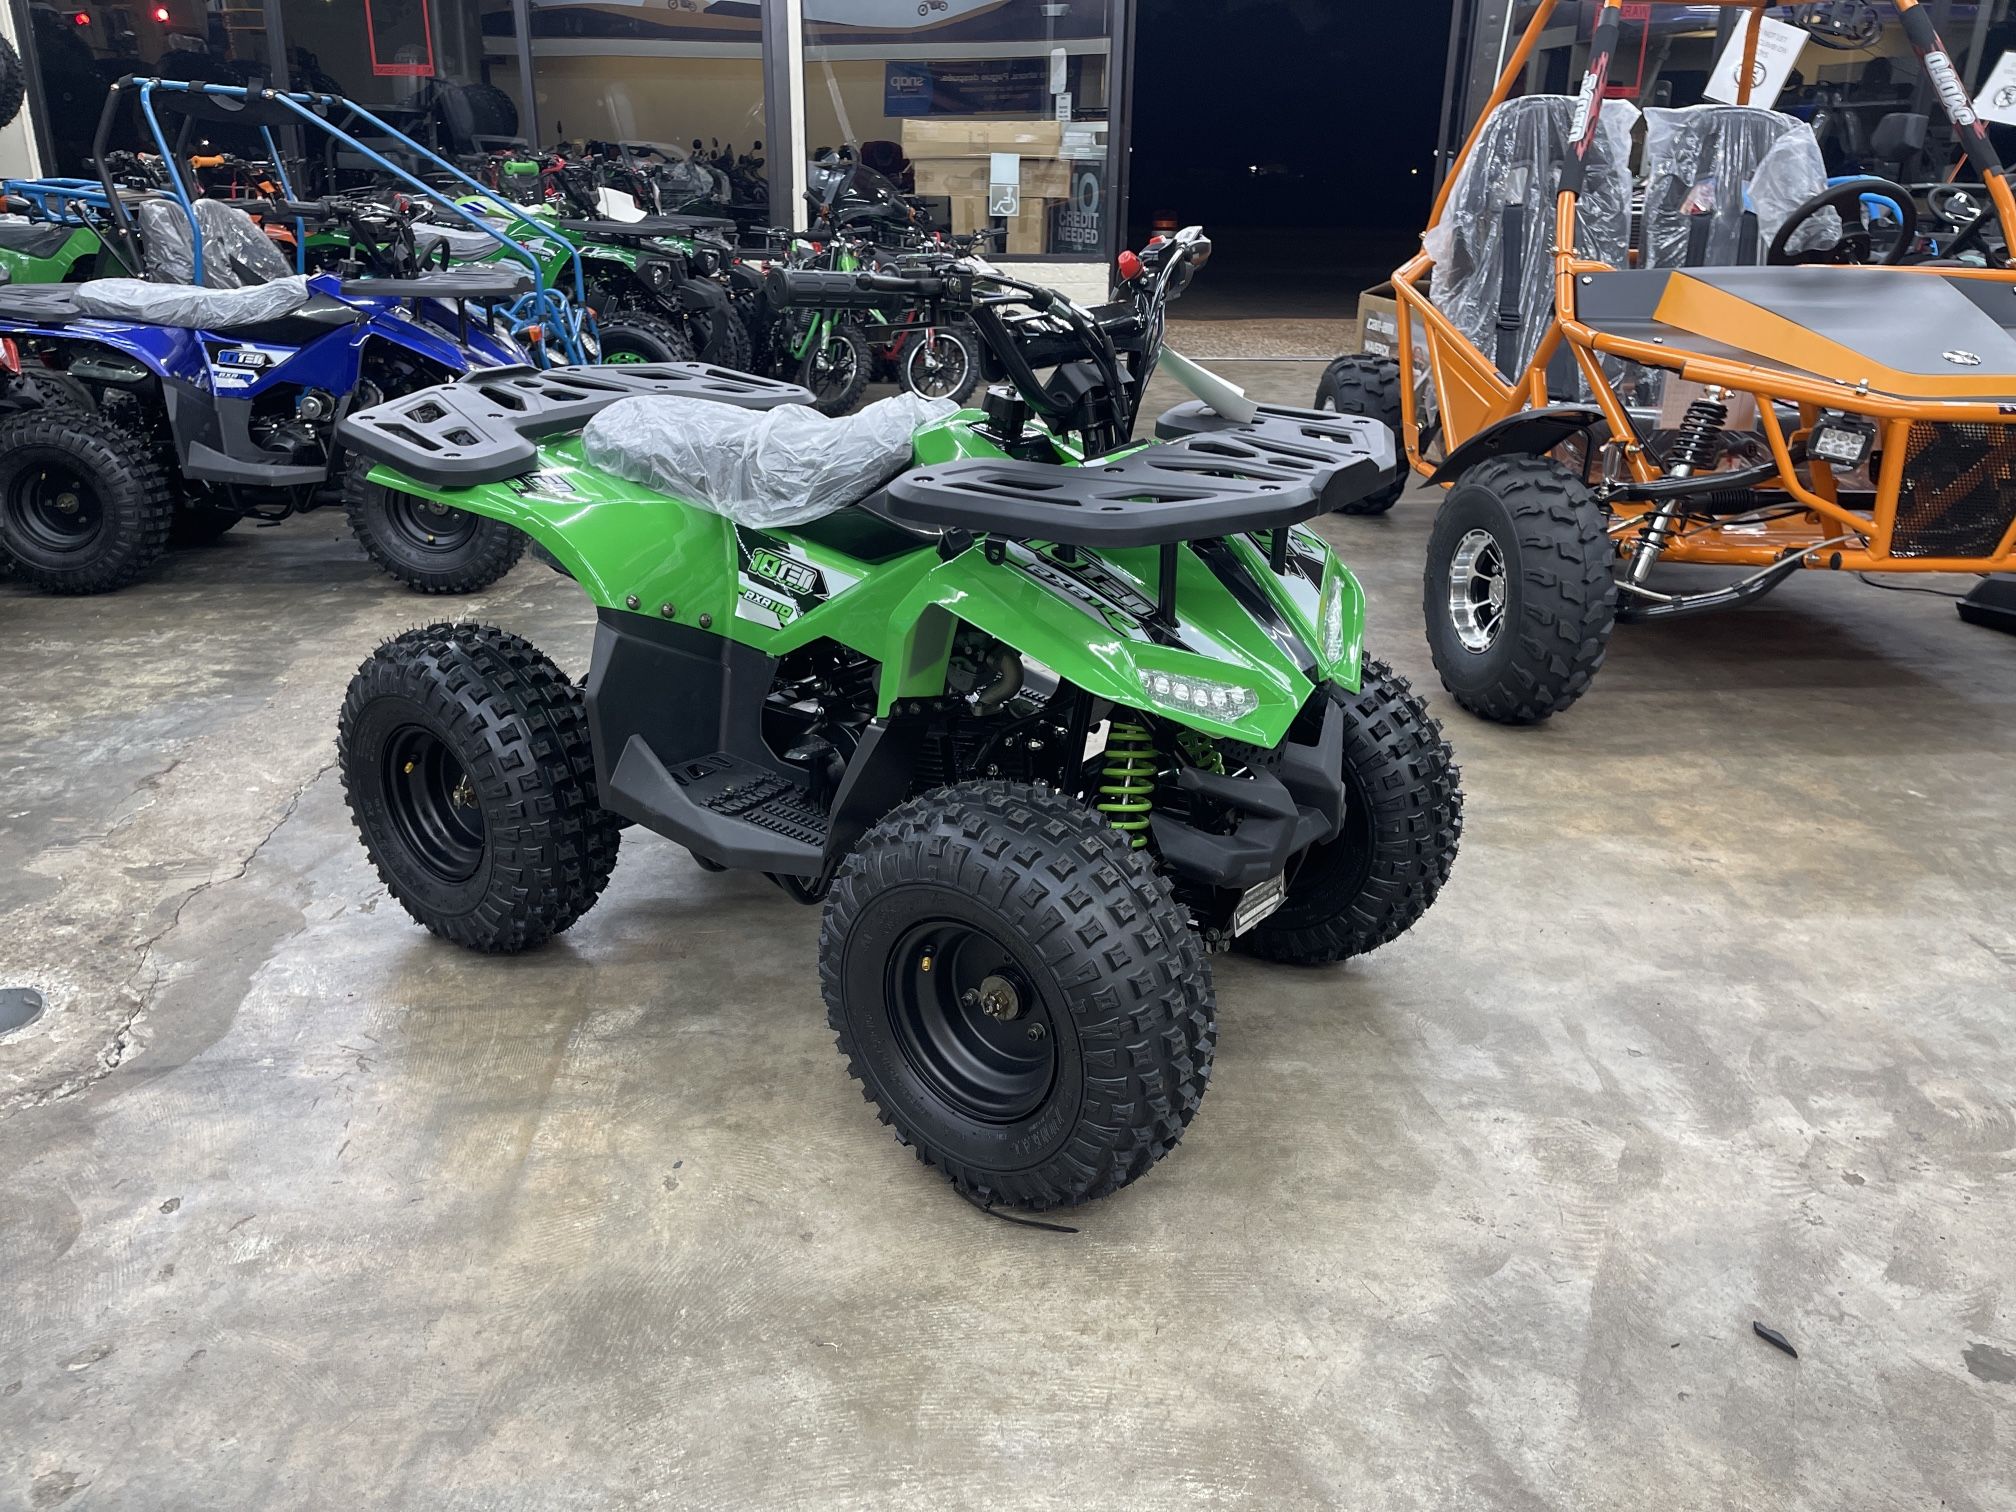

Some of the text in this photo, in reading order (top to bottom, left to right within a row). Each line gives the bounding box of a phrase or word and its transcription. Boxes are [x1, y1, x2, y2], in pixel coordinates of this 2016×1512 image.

[1058, 210, 1099, 229] CREDIT
[1057, 227, 1099, 245] NEEDED
[744, 589, 793, 618] RXR110
[1026, 563, 1139, 629] RXR110
